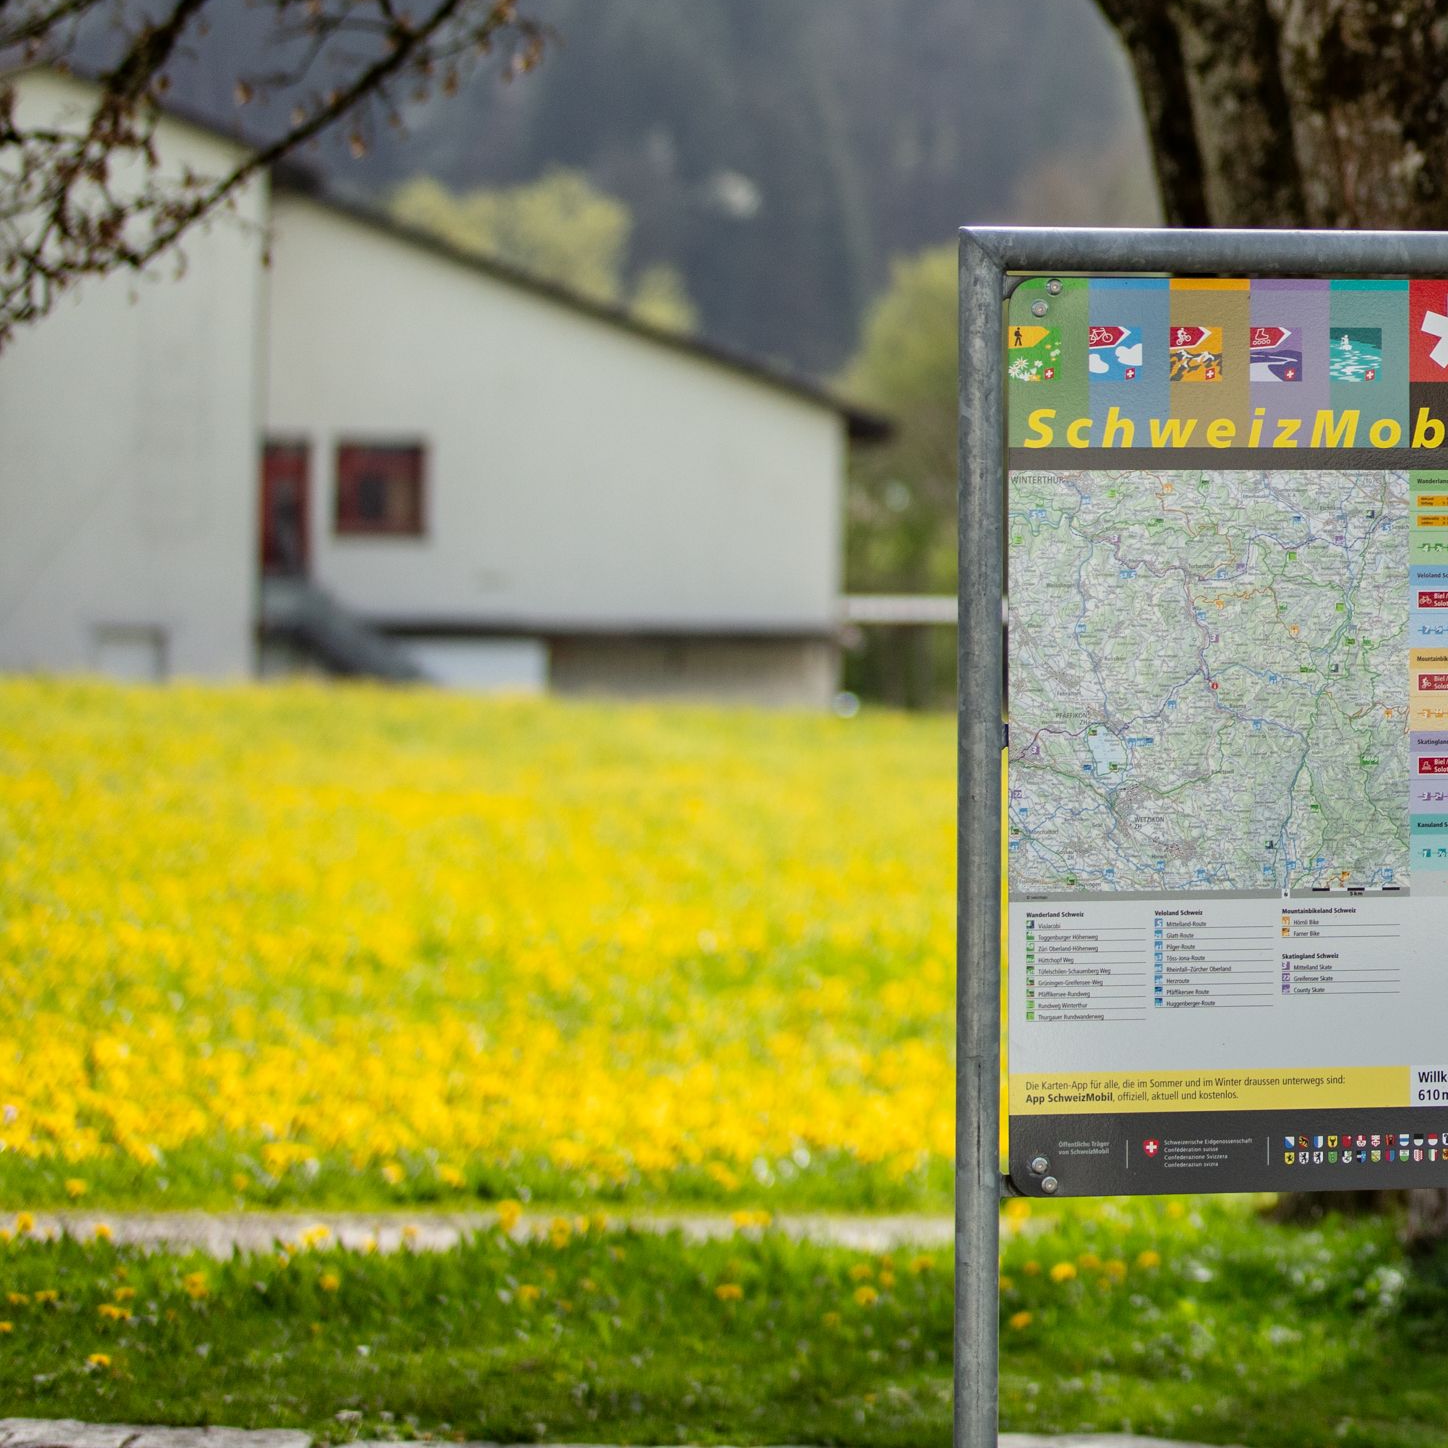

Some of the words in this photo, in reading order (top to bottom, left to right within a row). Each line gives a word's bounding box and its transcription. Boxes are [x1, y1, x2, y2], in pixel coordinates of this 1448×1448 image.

[1026, 1082, 1039, 1090] Die
[1042, 1081, 1088, 1091] Karten-App
[1090, 1080, 1101, 1089] für
[1104, 1080, 1120, 1089] alle,
[1123, 1080, 1135, 1088] die
[1138, 1080, 1147, 1088] im
[1150, 1079, 1183, 1088] Sommer
[1185, 1078, 1200, 1087] und
[1215, 1077, 1241, 1086] Winter
[1244, 1077, 1280, 1086] draussen
[1282, 1077, 1324, 1087] unterwegs
[1327, 1075, 1345, 1084] sind:
[1026, 1094, 1045, 1105] App
[1048, 1092, 1115, 1102] SchweizMobil,
[1118, 1091, 1149, 1102] offiziell,
[1151, 1090, 1178, 1100] aktuell
[1182, 1090, 1196, 1100] und
[1199, 1090, 1238, 1099] kostenlos.
